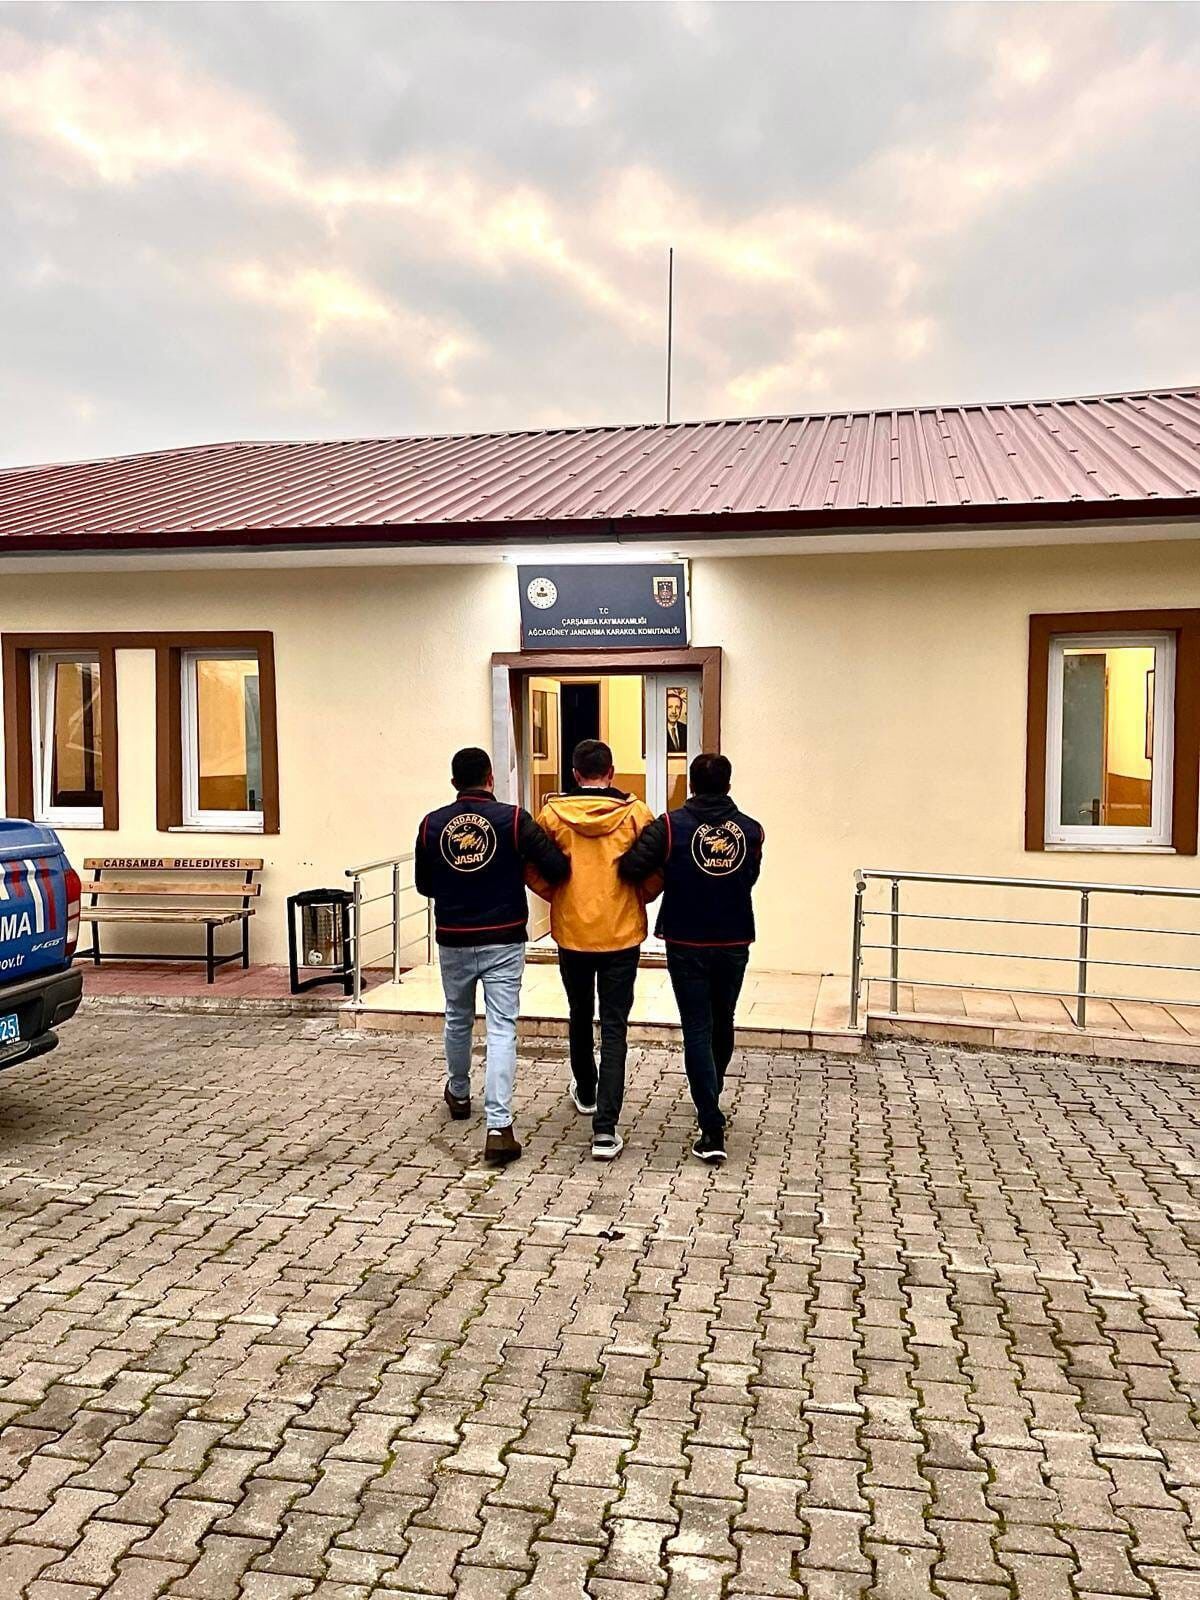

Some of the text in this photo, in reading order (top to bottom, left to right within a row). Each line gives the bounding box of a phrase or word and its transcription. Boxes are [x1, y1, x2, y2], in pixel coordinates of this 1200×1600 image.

[561, 616, 647, 627] ÇARŞAMBA KAYMAKAMLIĞI
[570, 628, 606, 636] JANDARMA
[606, 627, 637, 635] KARAKOL
[638, 626, 680, 635] KOMUTANLIĞI
[446, 815, 490, 837] JANDARMA
[174, 858, 240, 868] BELEDİYESİ
[454, 853, 484, 865] JASAT
[704, 858, 733, 868] JASAT
[0, 953, 25, 970] ov.tr
